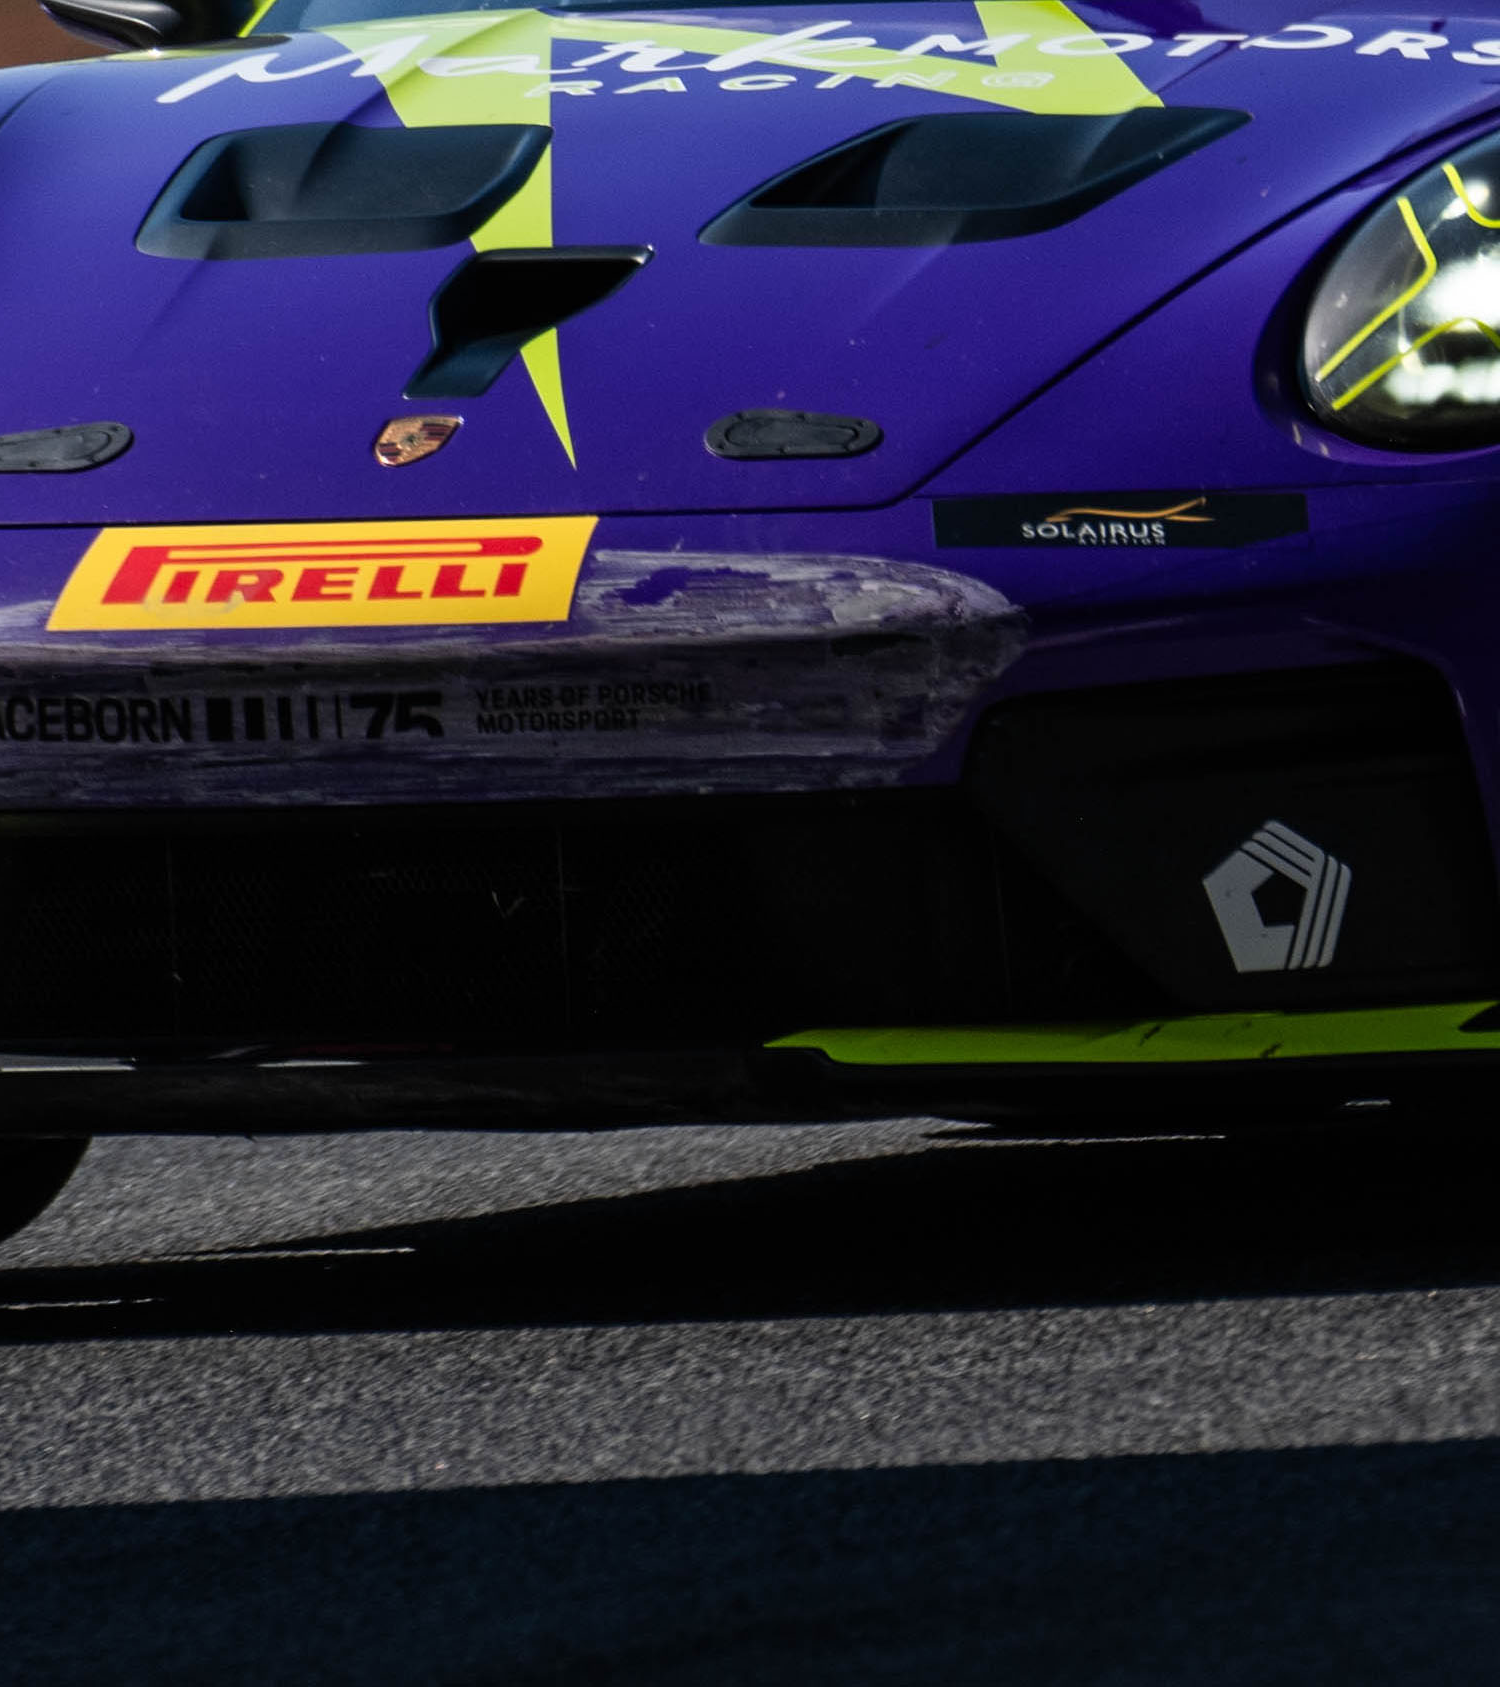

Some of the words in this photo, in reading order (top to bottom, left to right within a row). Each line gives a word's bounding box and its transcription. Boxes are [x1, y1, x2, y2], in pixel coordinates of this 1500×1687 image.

[157, 21, 882, 103] Mark
[525, 69, 1054, 97] RACING
[1020, 521, 1167, 540] SOLAIRUS
[99, 534, 544, 607] PIRELLI
[348, 692, 445, 742] 75
